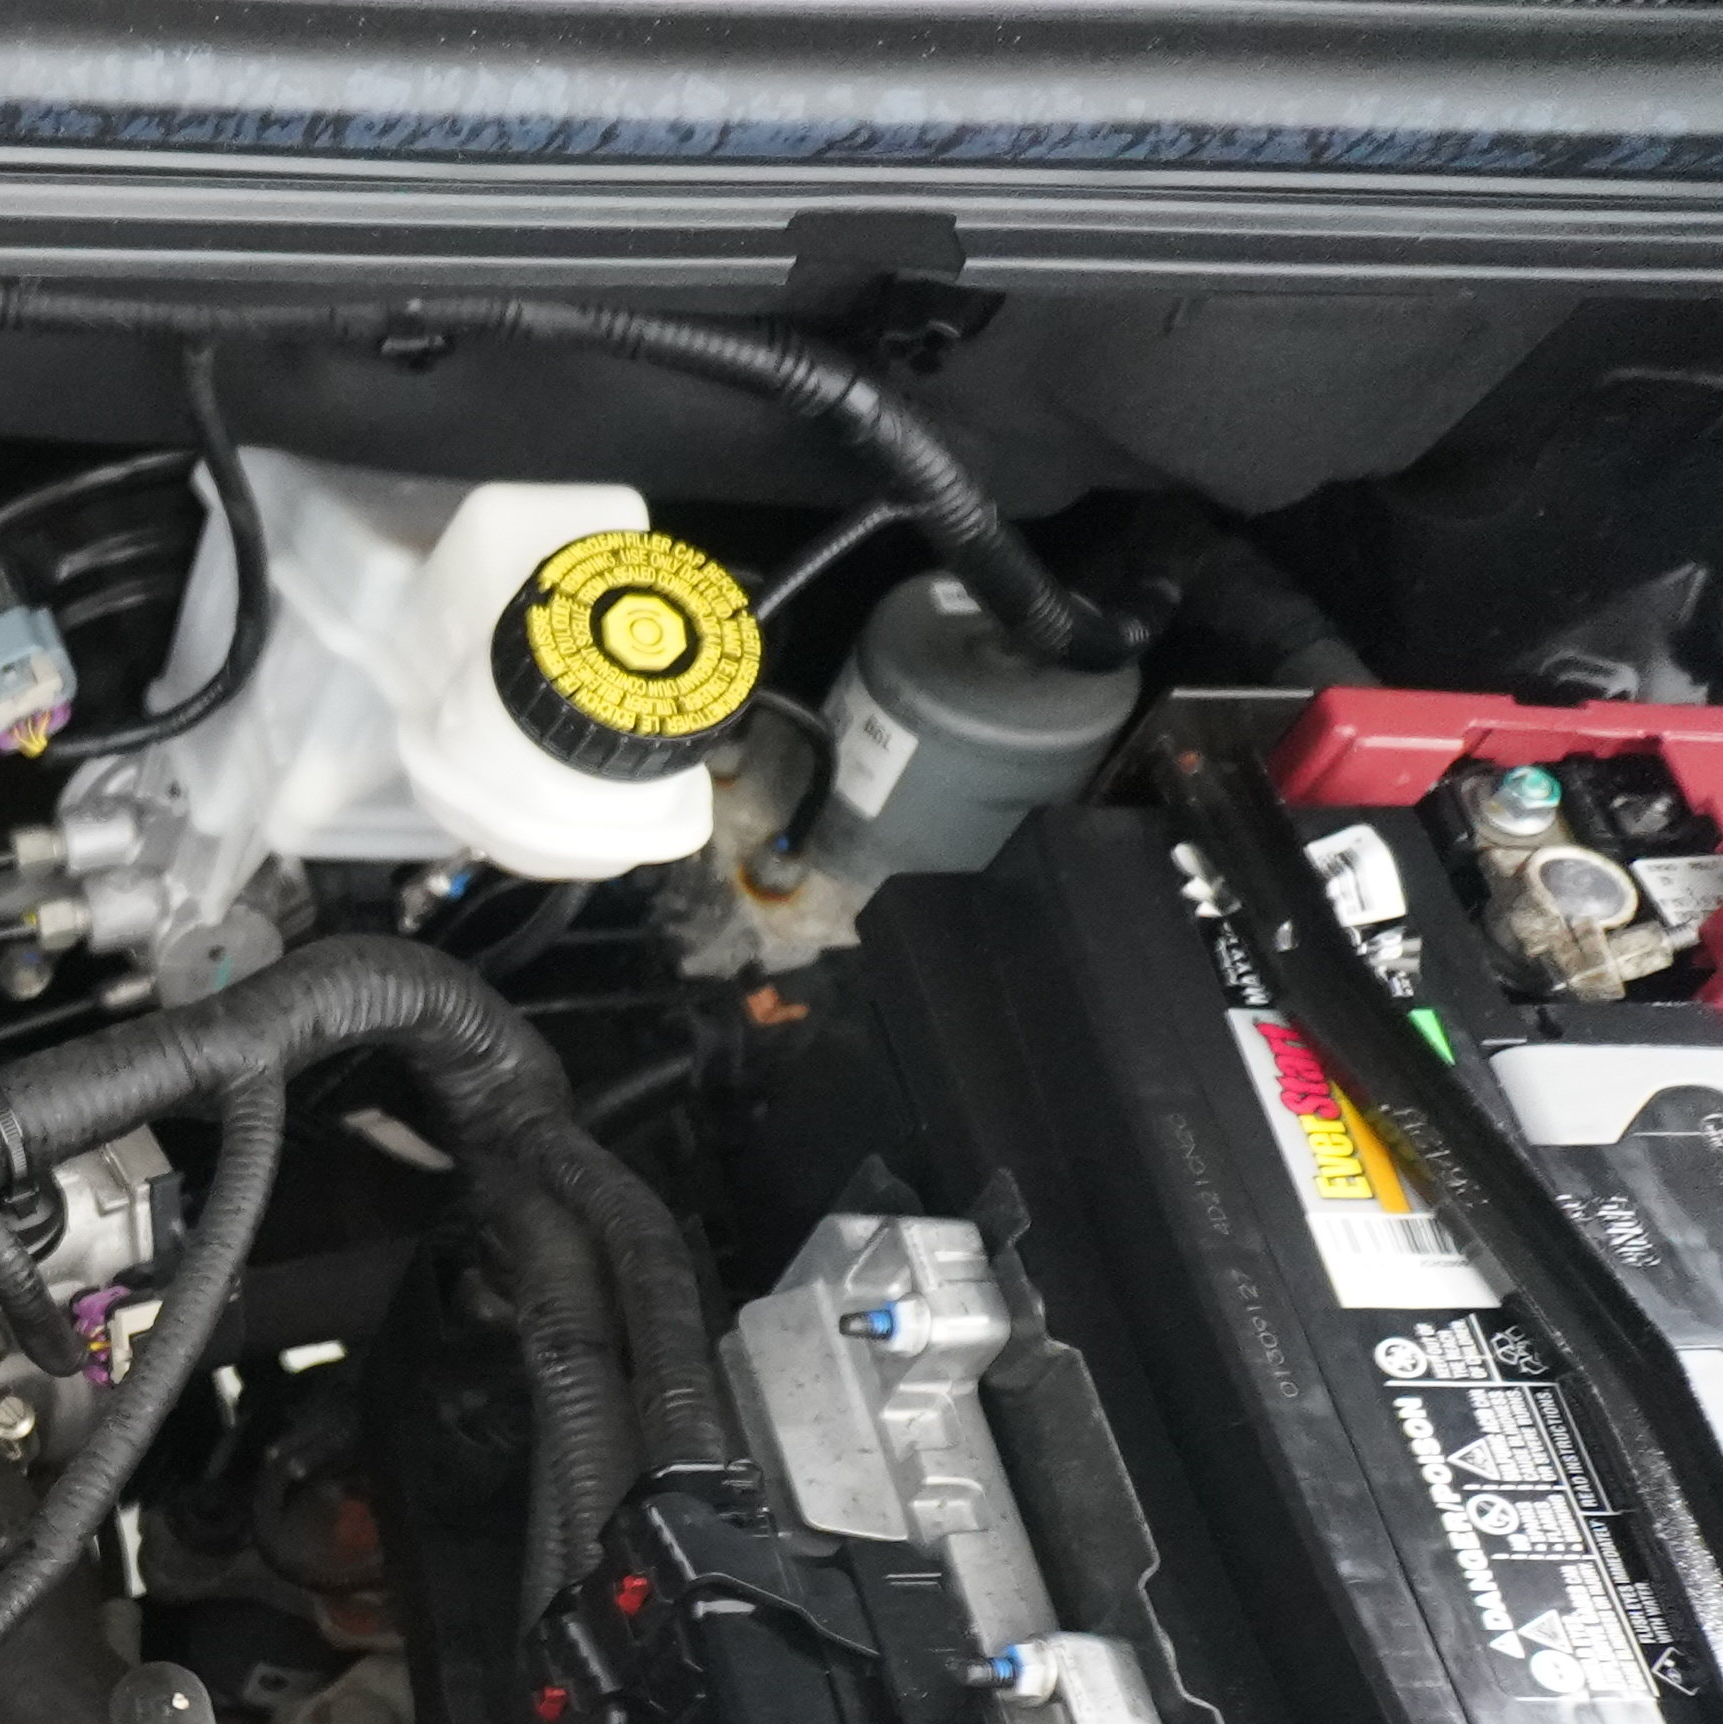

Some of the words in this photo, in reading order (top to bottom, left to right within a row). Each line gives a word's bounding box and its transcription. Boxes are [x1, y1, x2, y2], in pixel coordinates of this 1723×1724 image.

[612, 565, 656, 585] SEALED
[619, 548, 647, 567] USE
[649, 550, 681, 576] ONLY
[624, 530, 672, 555] FILLER
[672, 542, 706, 570] CAP
[700, 562, 747, 609] BEFORE
[551, 674, 577, 697] DE
[556, 653, 622, 710] SEULEMENT
[573, 647, 646, 700] CONTENANT
[570, 690, 635, 732] BOUCHON
[622, 696, 679, 718] UTILISER
[643, 717, 661, 735] LE
[1255, 1022, 1374, 1200] EverStart
[1487, 1391, 1525, 1445] BLINDNESS
[1520, 1428, 1549, 1463] SEVERE
[1567, 1474, 1599, 1506] READ
[1392, 1397, 1514, 1629] DANGER/POISON
[1587, 1519, 1631, 1583] IMMEDIATELY
[1615, 1585, 1643, 1609] EYES
[1626, 1611, 1657, 1643] FLUSH
